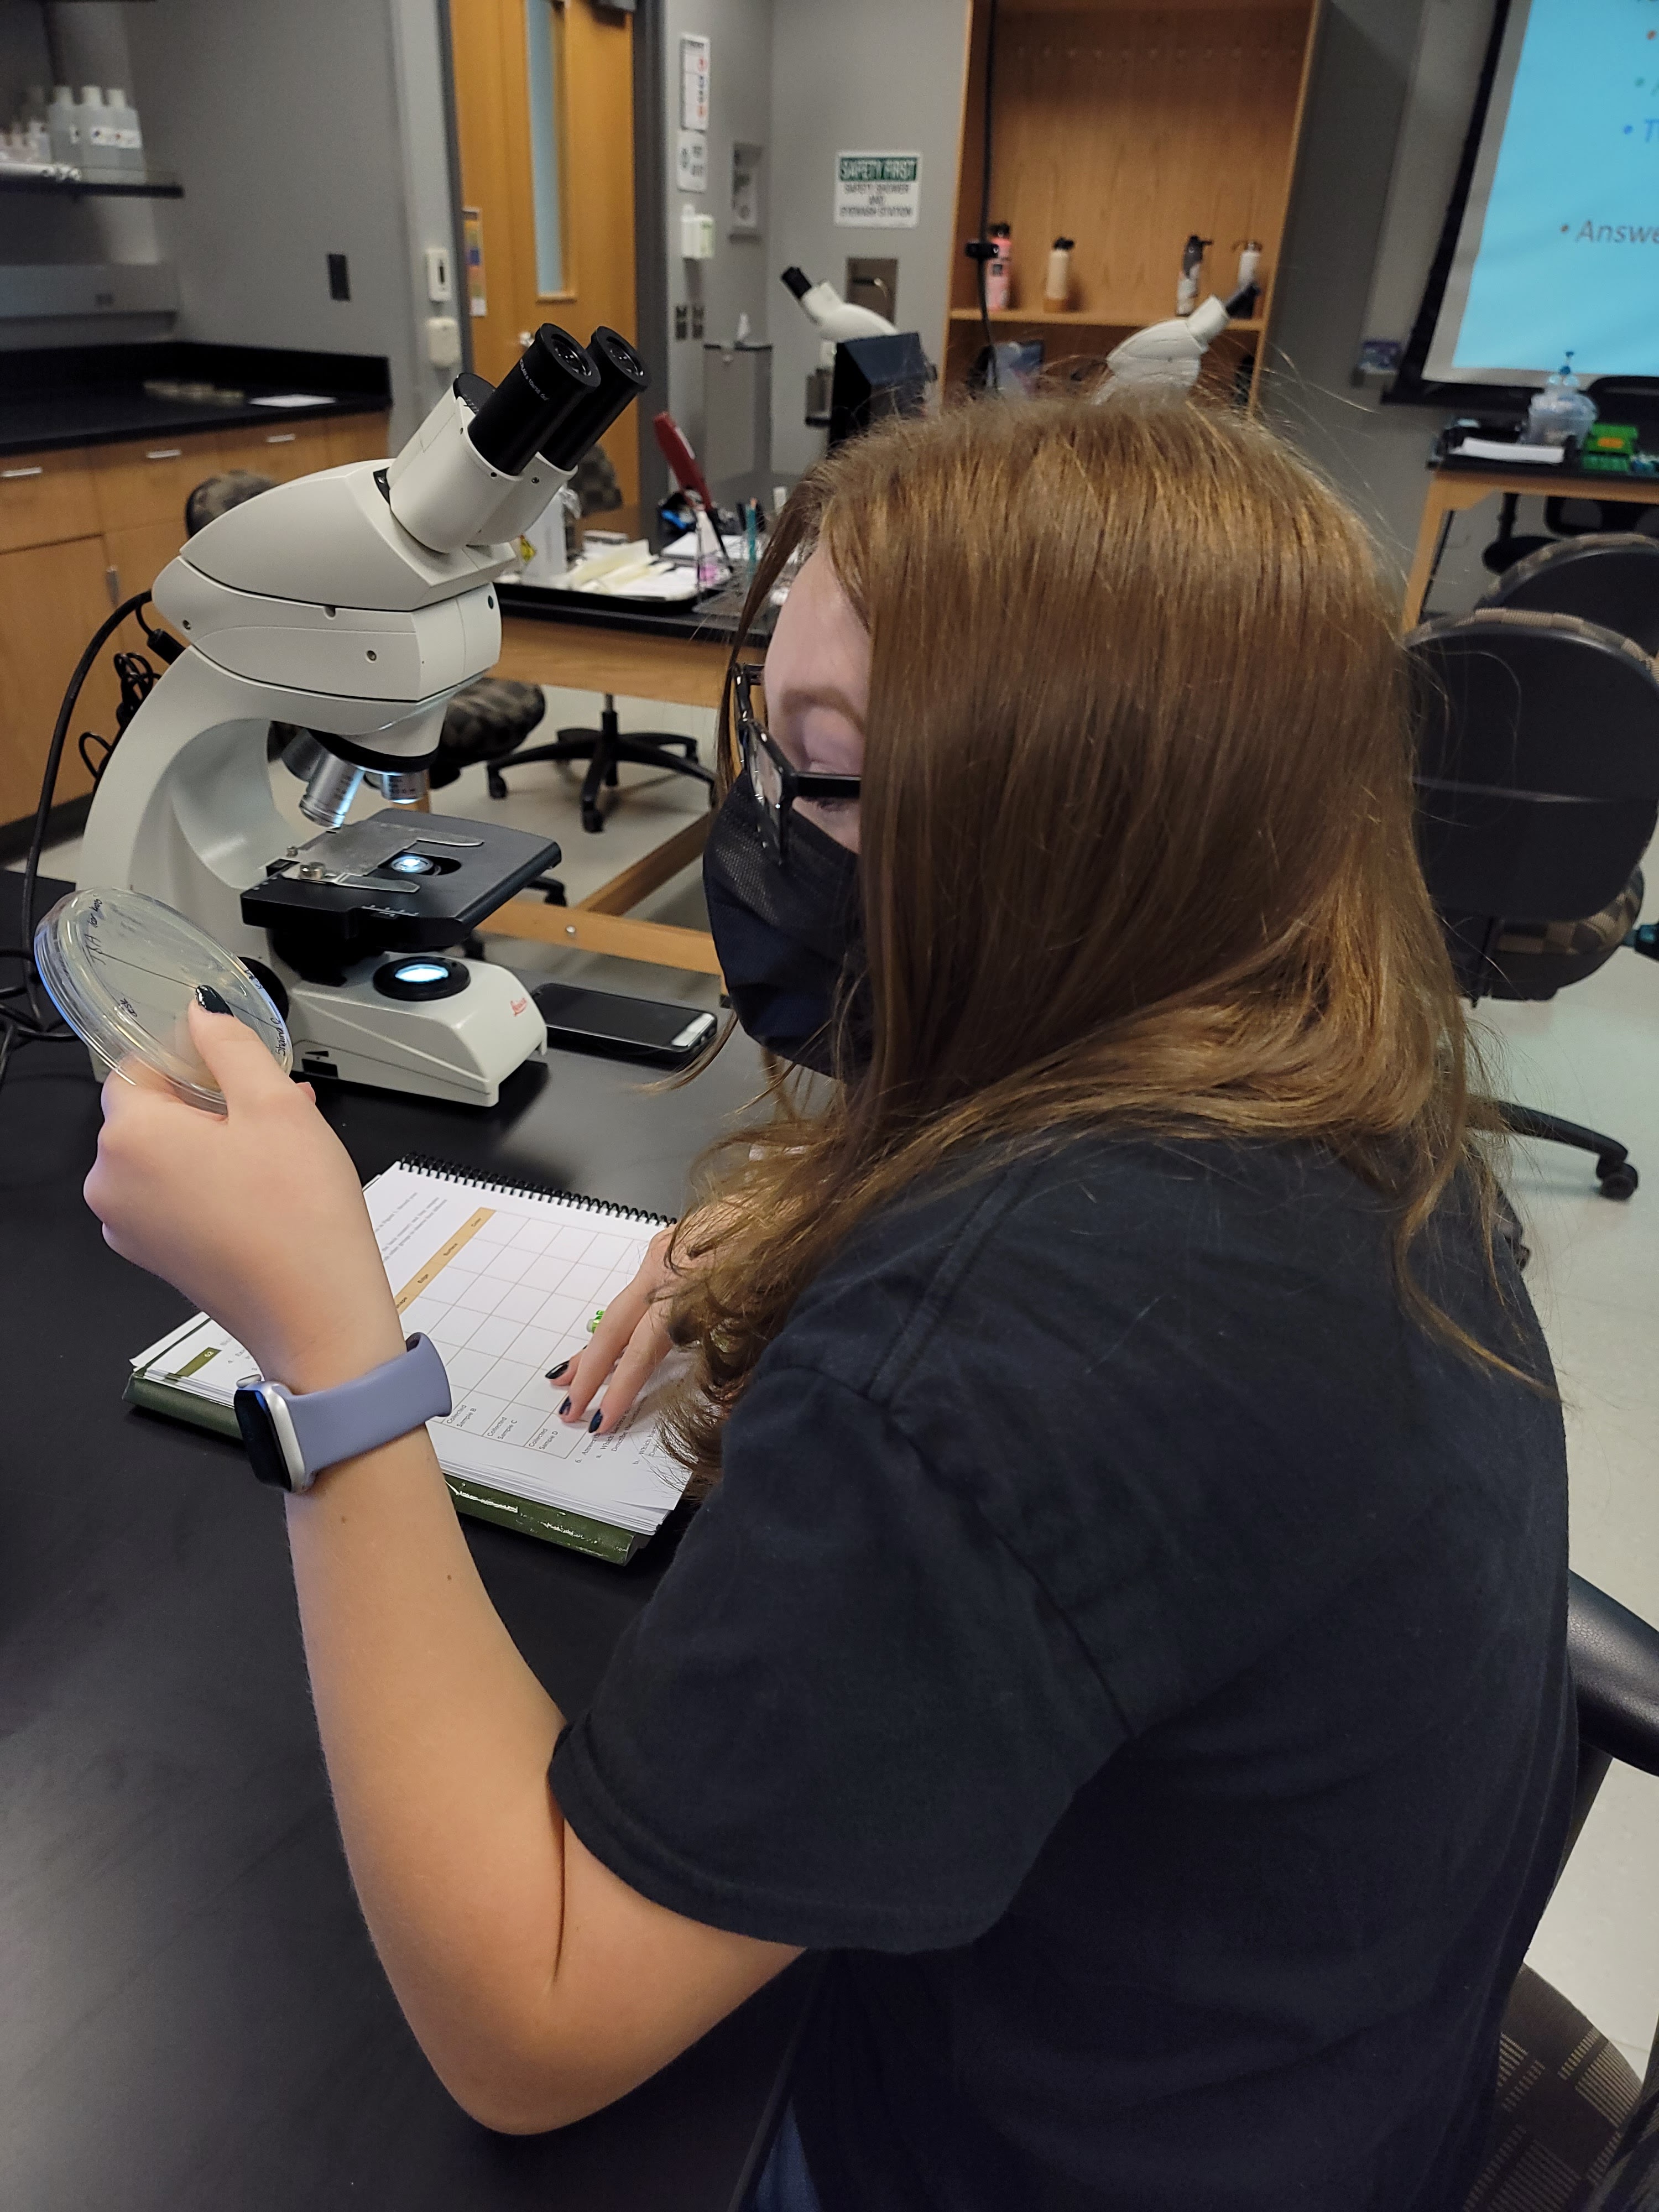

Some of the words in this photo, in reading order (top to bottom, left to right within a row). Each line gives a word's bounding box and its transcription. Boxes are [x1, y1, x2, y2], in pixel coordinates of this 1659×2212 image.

[841, 159, 883, 180] SAFETY
[885, 159, 915, 180] FIRST
[446, 1405, 467, 1424] Collected
[457, 1412, 472, 1427] Sample
[487, 1417, 507, 1437] Collected
[498, 1423, 514, 1439] Sample
[529, 1428, 548, 1447] Collected
[539, 1434, 555, 1450] Sample
[600, 1434, 615, 1450] Which
[611, 1431, 629, 1452] Describe
[582, 1439, 597, 1456] Answer
